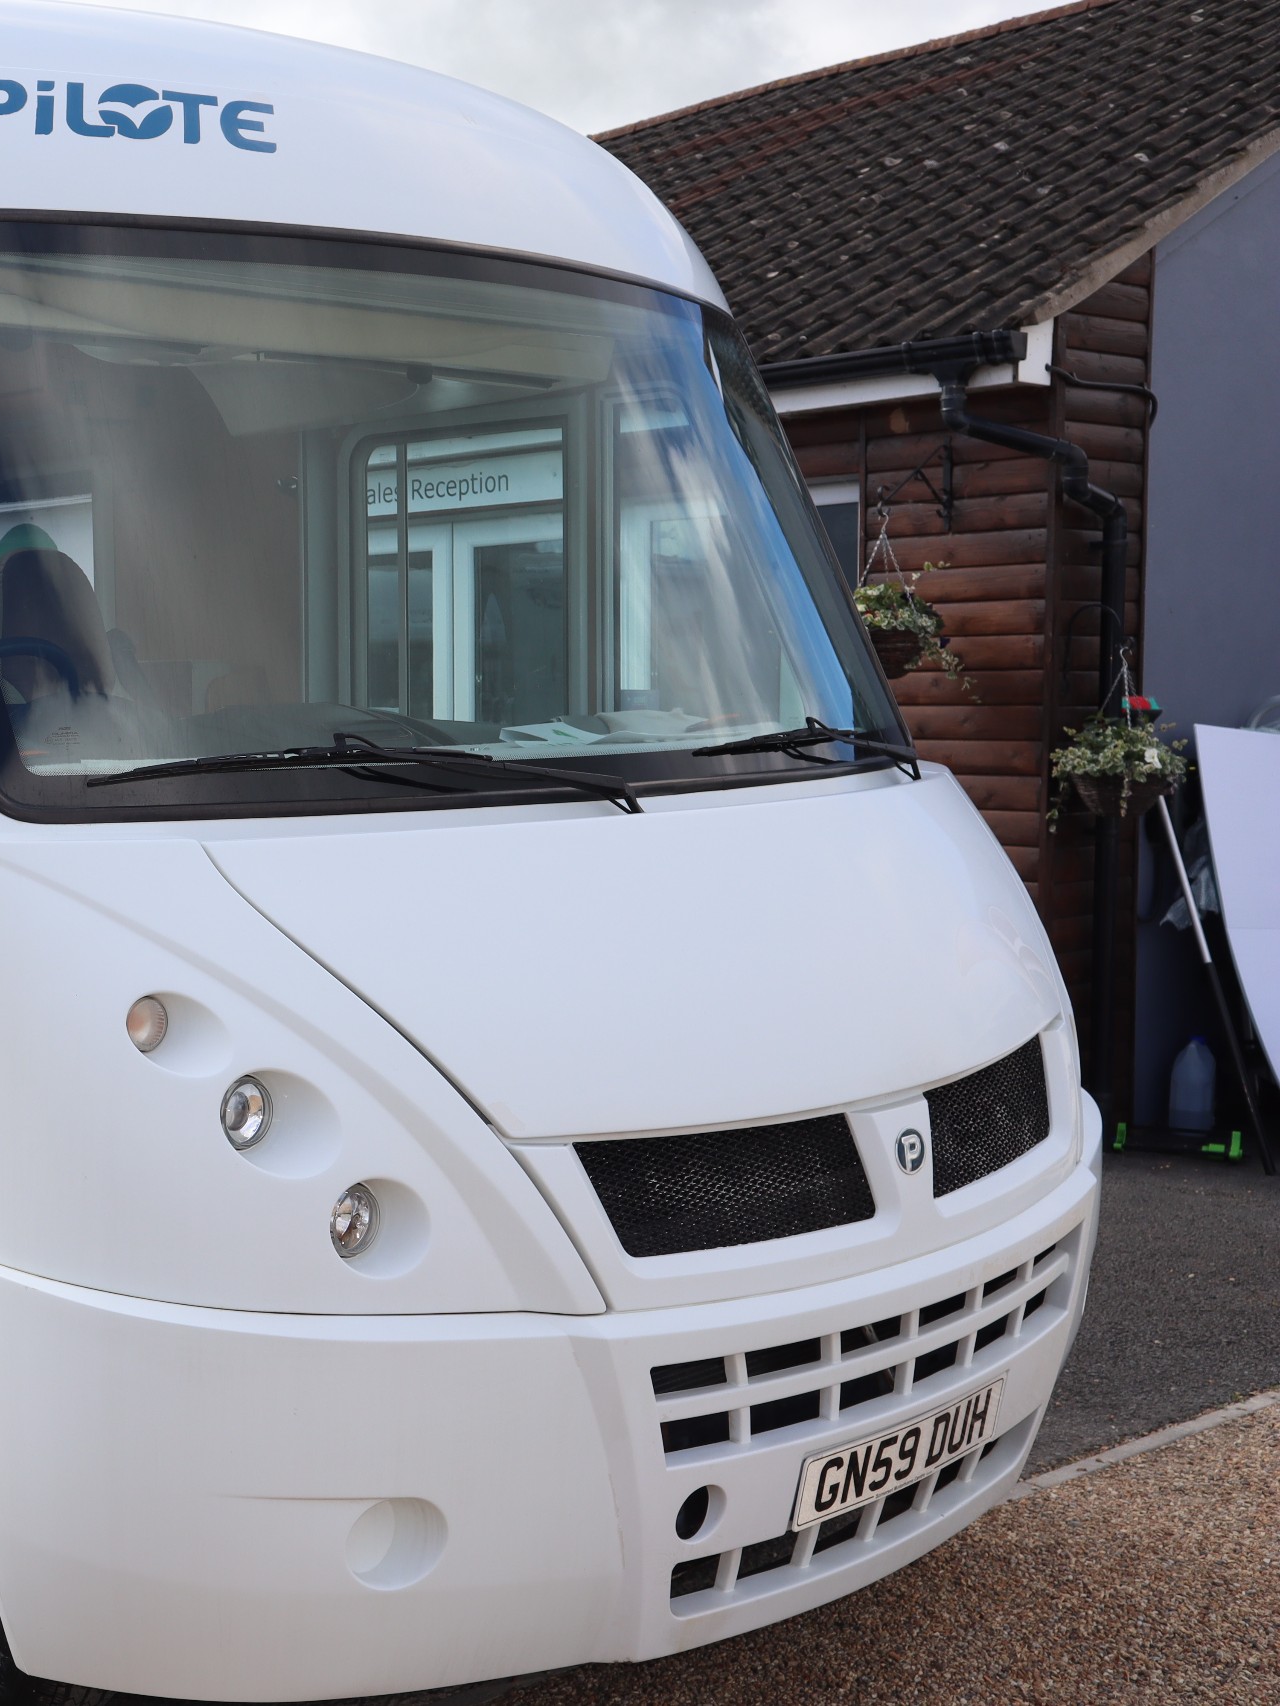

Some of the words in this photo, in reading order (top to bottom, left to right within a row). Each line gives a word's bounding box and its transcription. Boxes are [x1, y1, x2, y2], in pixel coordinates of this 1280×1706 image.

[366, 481, 398, 505] ale
[411, 472, 509, 501] Reception
[814, 1427, 921, 1512] GN59
[925, 1388, 992, 1468] DUH
